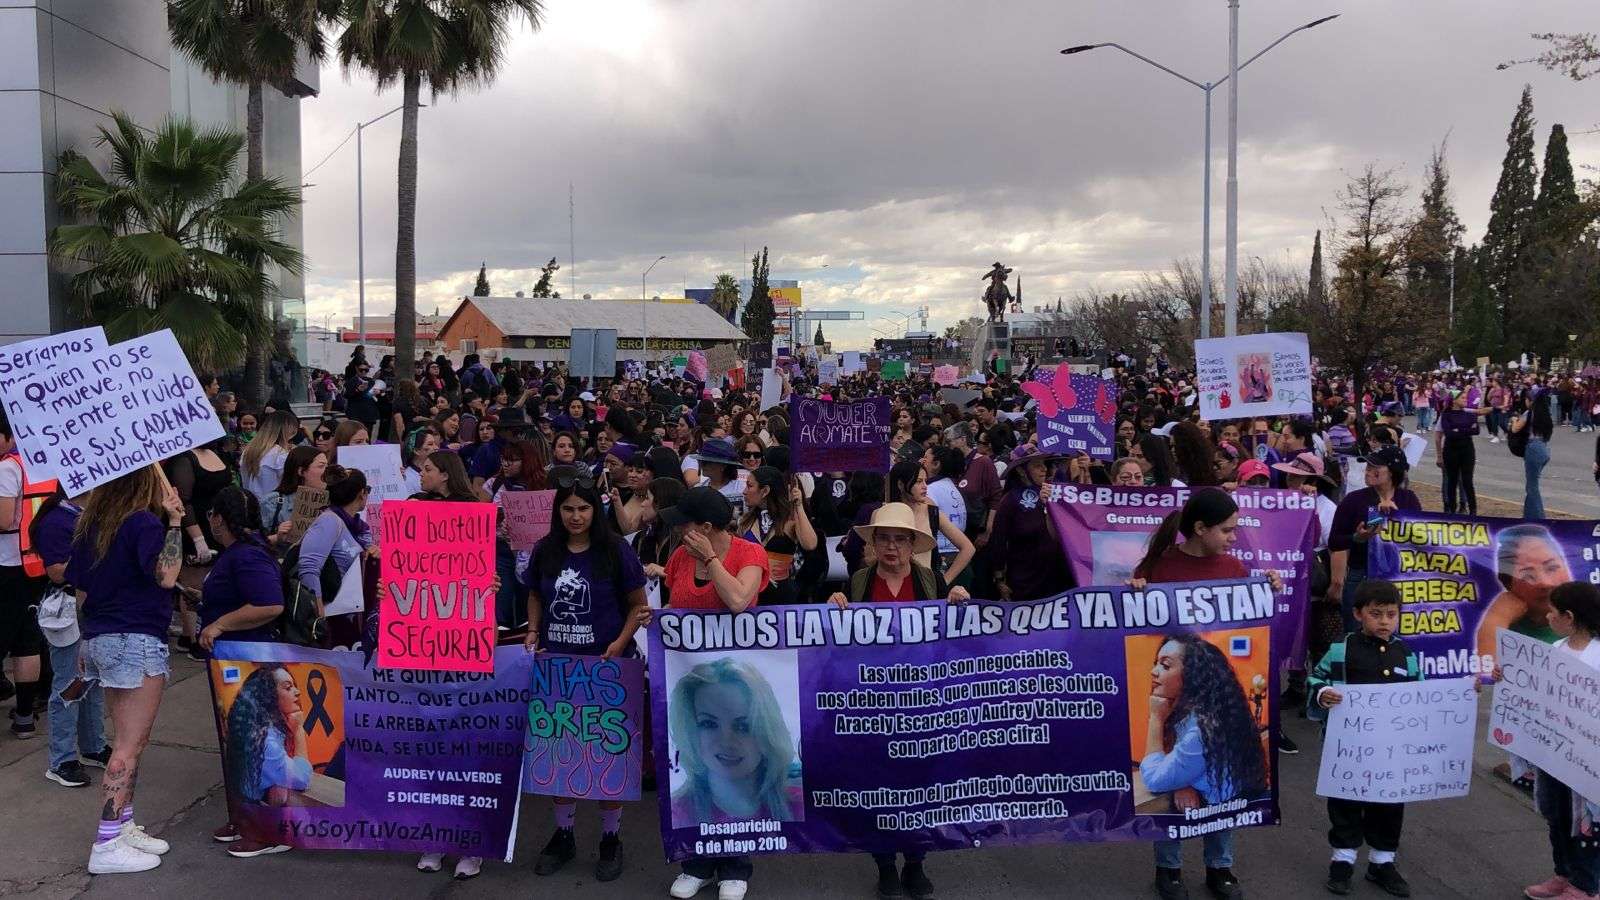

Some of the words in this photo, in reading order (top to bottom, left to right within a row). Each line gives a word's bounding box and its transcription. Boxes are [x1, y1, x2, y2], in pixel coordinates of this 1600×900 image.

[546, 339, 571, 348] CEN
[617, 340, 643, 348] RERO
[25, 367, 84, 403] Quien
[92, 355, 122, 374] no
[130, 345, 152, 364] se
[53, 377, 122, 414] mueve,
[129, 367, 154, 386] no
[122, 393, 140, 410] el
[143, 374, 194, 405] ruido
[799, 400, 876, 425] MUJER
[60, 448, 85, 467] de
[131, 397, 210, 441] CADENAS
[68, 431, 193, 490] #NiUnaMenos
[427, 514, 490, 544] basta!!
[1106, 513, 1163, 525] Germán
[1237, 516, 1260, 527] eña
[1380, 518, 1490, 546] JUSTICIA
[1258, 550, 1272, 560] la
[1400, 550, 1467, 575] PARA
[572, 625, 592, 633] SOMOS
[660, 611, 779, 649] SOMOS
[786, 609, 826, 647] LA
[829, 608, 894, 646] VOZ
[900, 605, 941, 643] DE
[946, 604, 1003, 636] LAS
[1009, 597, 1070, 634] QUE
[1074, 591, 1117, 628] YA
[1122, 590, 1169, 627] NO
[1174, 583, 1275, 625] ESTAN
[1400, 610, 1461, 635] BACA
[388, 621, 493, 665] SEGURAS
[563, 632, 594, 644] FUERTES
[372, 669, 395, 682] ME
[400, 667, 495, 683] QUITARON
[859, 663, 885, 683] Las
[887, 663, 928, 683] vidas
[930, 662, 947, 680] no
[949, 659, 974, 678] son
[977, 650, 1073, 673] negociables,
[1503, 664, 1539, 691] CON
[531, 657, 626, 706] NTAS
[817, 692, 846, 710] nos
[848, 691, 897, 709] deben
[898, 689, 942, 708] miles,
[944, 683, 970, 707] que
[972, 676, 1016, 698] nunca
[1019, 678, 1038, 694] se
[1039, 675, 1064, 692] les
[1066, 673, 1118, 694] olvide,
[345, 687, 412, 705] TANTO...
[417, 690, 452, 706] QUE
[458, 687, 530, 706] CUANDO
[1347, 688, 1473, 709] RECONOSE
[354, 712, 370, 729] LE
[374, 711, 499, 732] ARREBATARON
[506, 712, 525, 730] SU
[528, 699, 631, 755] BRES
[835, 715, 894, 735] Aracely
[895, 710, 969, 734] Escarcega
[969, 705, 981, 724] y
[981, 701, 1034, 723] Audrey
[1035, 699, 1104, 720] Valverde
[1344, 717, 1377, 732] ME
[1391, 716, 1428, 731] SOY
[1438, 710, 1469, 725] TU
[346, 737, 386, 755] VIDA,
[393, 739, 410, 755] SE
[415, 738, 446, 757] FUE
[450, 738, 471, 756] MI
[889, 740, 918, 758] son
[919, 736, 958, 758] parte
[959, 730, 977, 749] de
[979, 726, 1007, 745] esa
[1008, 724, 1049, 745] cifra!
[1338, 739, 1375, 762] hijo
[383, 767, 436, 782] AUDREY
[436, 769, 502, 785] VALVERDE
[387, 791, 395, 803] 5
[398, 791, 465, 806] DICIEMBRE
[469, 795, 498, 809] 2021
[813, 790, 835, 807] ya
[836, 789, 858, 807] les
[861, 787, 924, 809] quitaron
[927, 785, 941, 802] el
[943, 777, 1012, 804] privilegio
[1014, 774, 1033, 795] de
[1035, 773, 1071, 794] vivir
[1072, 774, 1091, 792] su
[1091, 771, 1130, 792] vida,
[877, 813, 897, 830] no
[900, 810, 922, 830] les
[924, 803, 972, 828] quiten
[973, 804, 994, 822] su
[994, 799, 1068, 820] recuerdo.
[1185, 797, 1248, 820] Feminicidio
[278, 819, 482, 846] #YoSoyTuVozAmiga
[700, 819, 781, 836] Desaparición
[1167, 824, 1178, 840] 5
[1179, 817, 1235, 839] Diciembre
[1236, 810, 1263, 826] 2021
[695, 840, 704, 854] 6
[705, 840, 721, 853] de
[723, 839, 757, 854] Mayo
[758, 836, 787, 851] 2010
